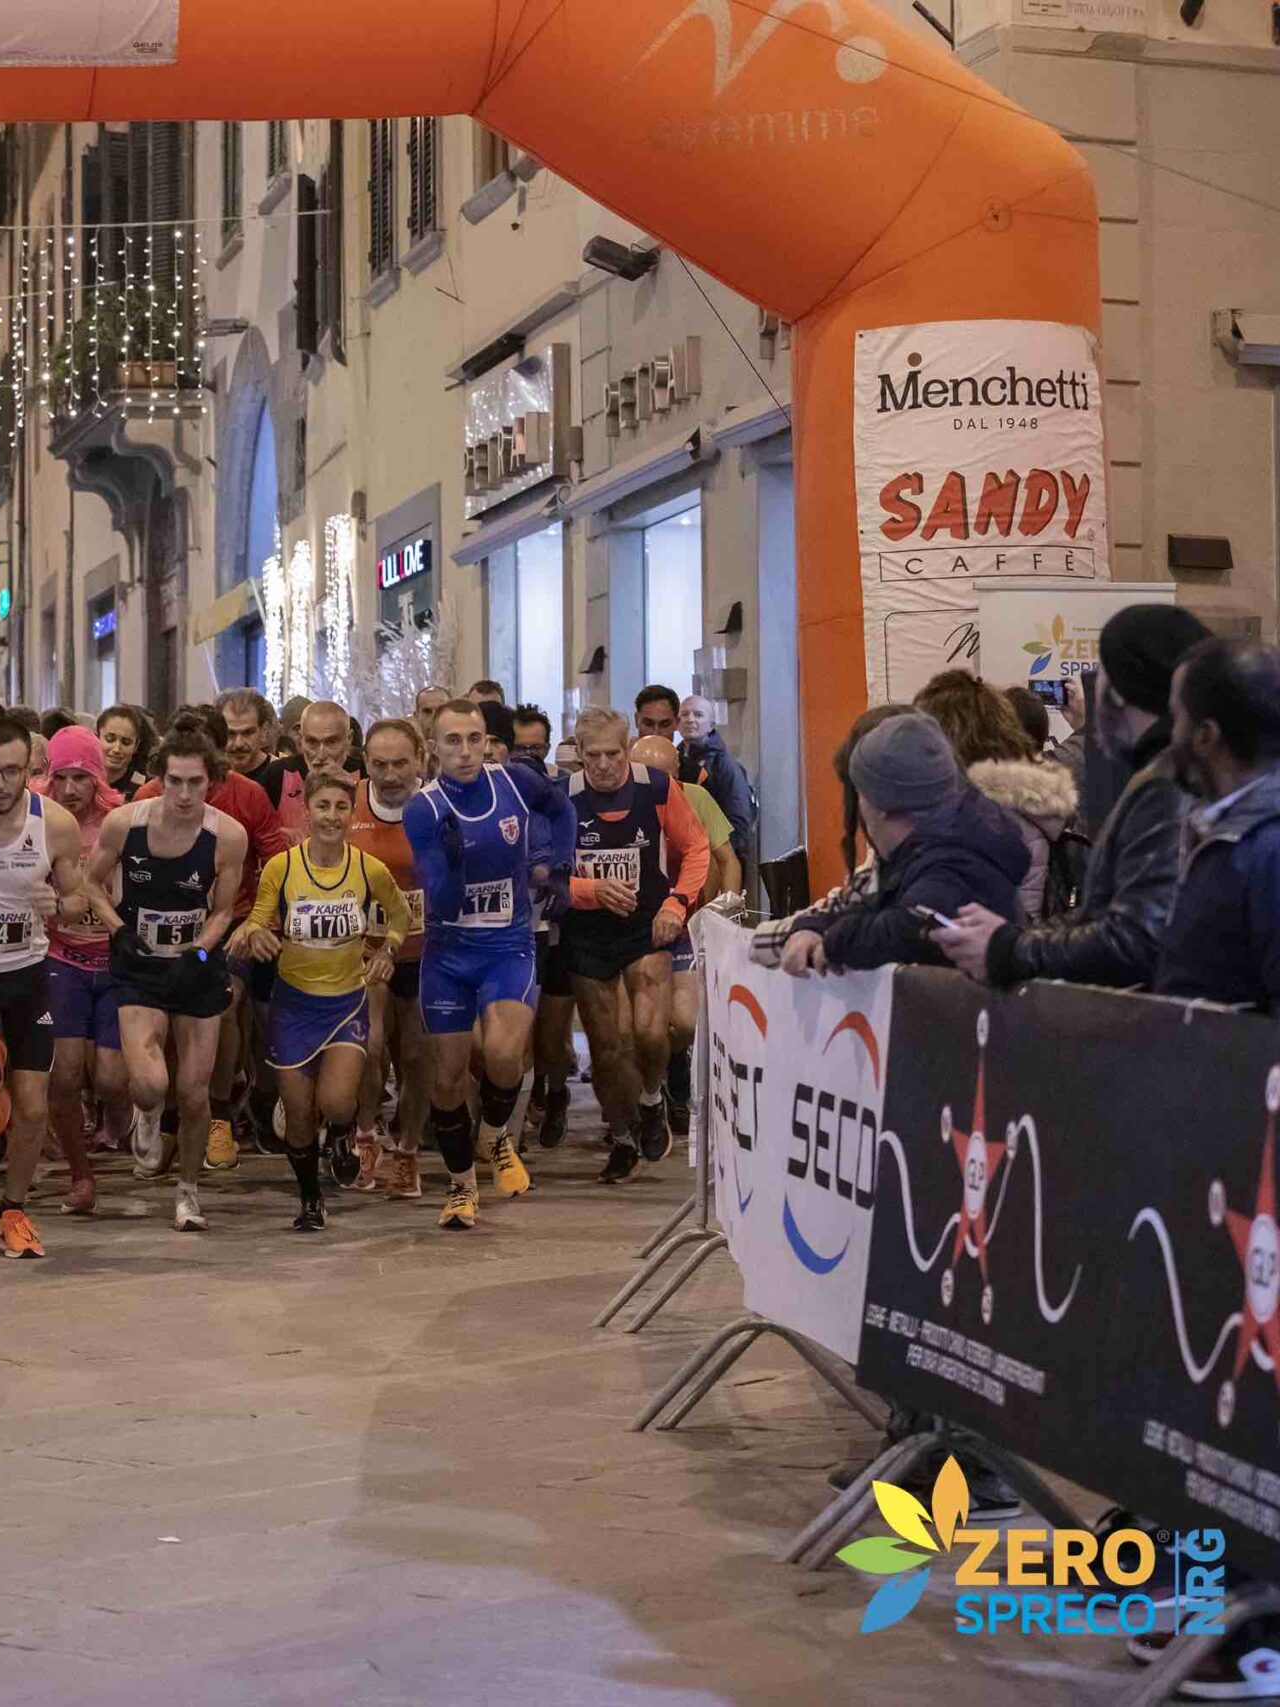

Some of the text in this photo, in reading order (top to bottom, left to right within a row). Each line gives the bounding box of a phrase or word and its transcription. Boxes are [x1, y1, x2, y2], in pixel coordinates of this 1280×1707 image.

[877, 353, 1089, 413] Menchetti
[953, 417, 1039, 430] DAL 1948
[879, 468, 1091, 541] SANDY
[904, 550, 1074, 575] CAFFÈ
[597, 852, 635, 863] KARHU
[595, 863, 628, 882] 140
[467, 881, 508, 895] KARHU
[315, 902, 354, 915] KARHU
[471, 893, 492, 913] 17
[163, 912, 202, 924] KARHU
[312, 913, 350, 938] 170
[170, 925, 183, 946] 5
[787, 1082, 878, 1211] SECO
